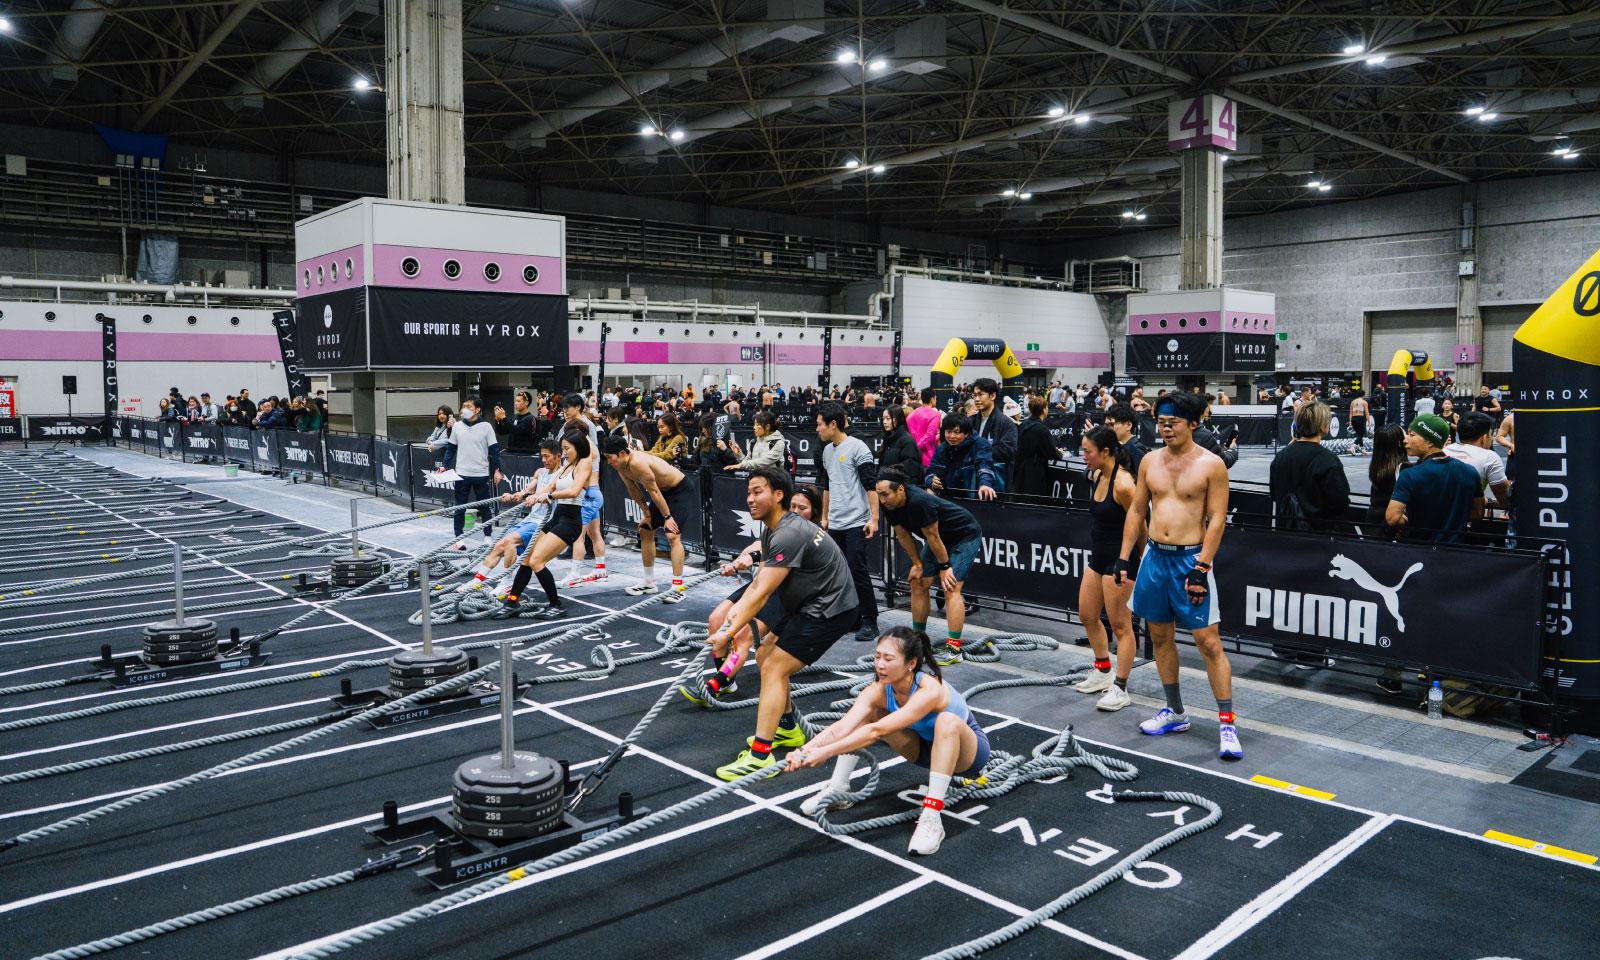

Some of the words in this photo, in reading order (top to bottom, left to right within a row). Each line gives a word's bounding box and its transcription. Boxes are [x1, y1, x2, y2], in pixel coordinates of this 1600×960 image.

[1180, 100, 1209, 140] 4
[1218, 101, 1236, 141] 4
[404, 322, 421, 335] OUR
[424, 323, 450, 336] SPORT
[452, 323, 460, 336] IS
[469, 323, 540, 337] HYROX
[317, 334, 340, 346] HYROX
[973, 344, 1000, 353] ROWING
[1234, 344, 1266, 355] HYROX
[317, 351, 341, 360] OSAKA
[1520, 388, 1589, 401] HYROX
[42, 426, 87, 436] NITRO
[1537, 436, 1570, 528] PULL
[1245, 585, 1378, 646] PUMA
[400, 709, 429, 721] CENTR
[465, 857, 509, 875] CENTR
